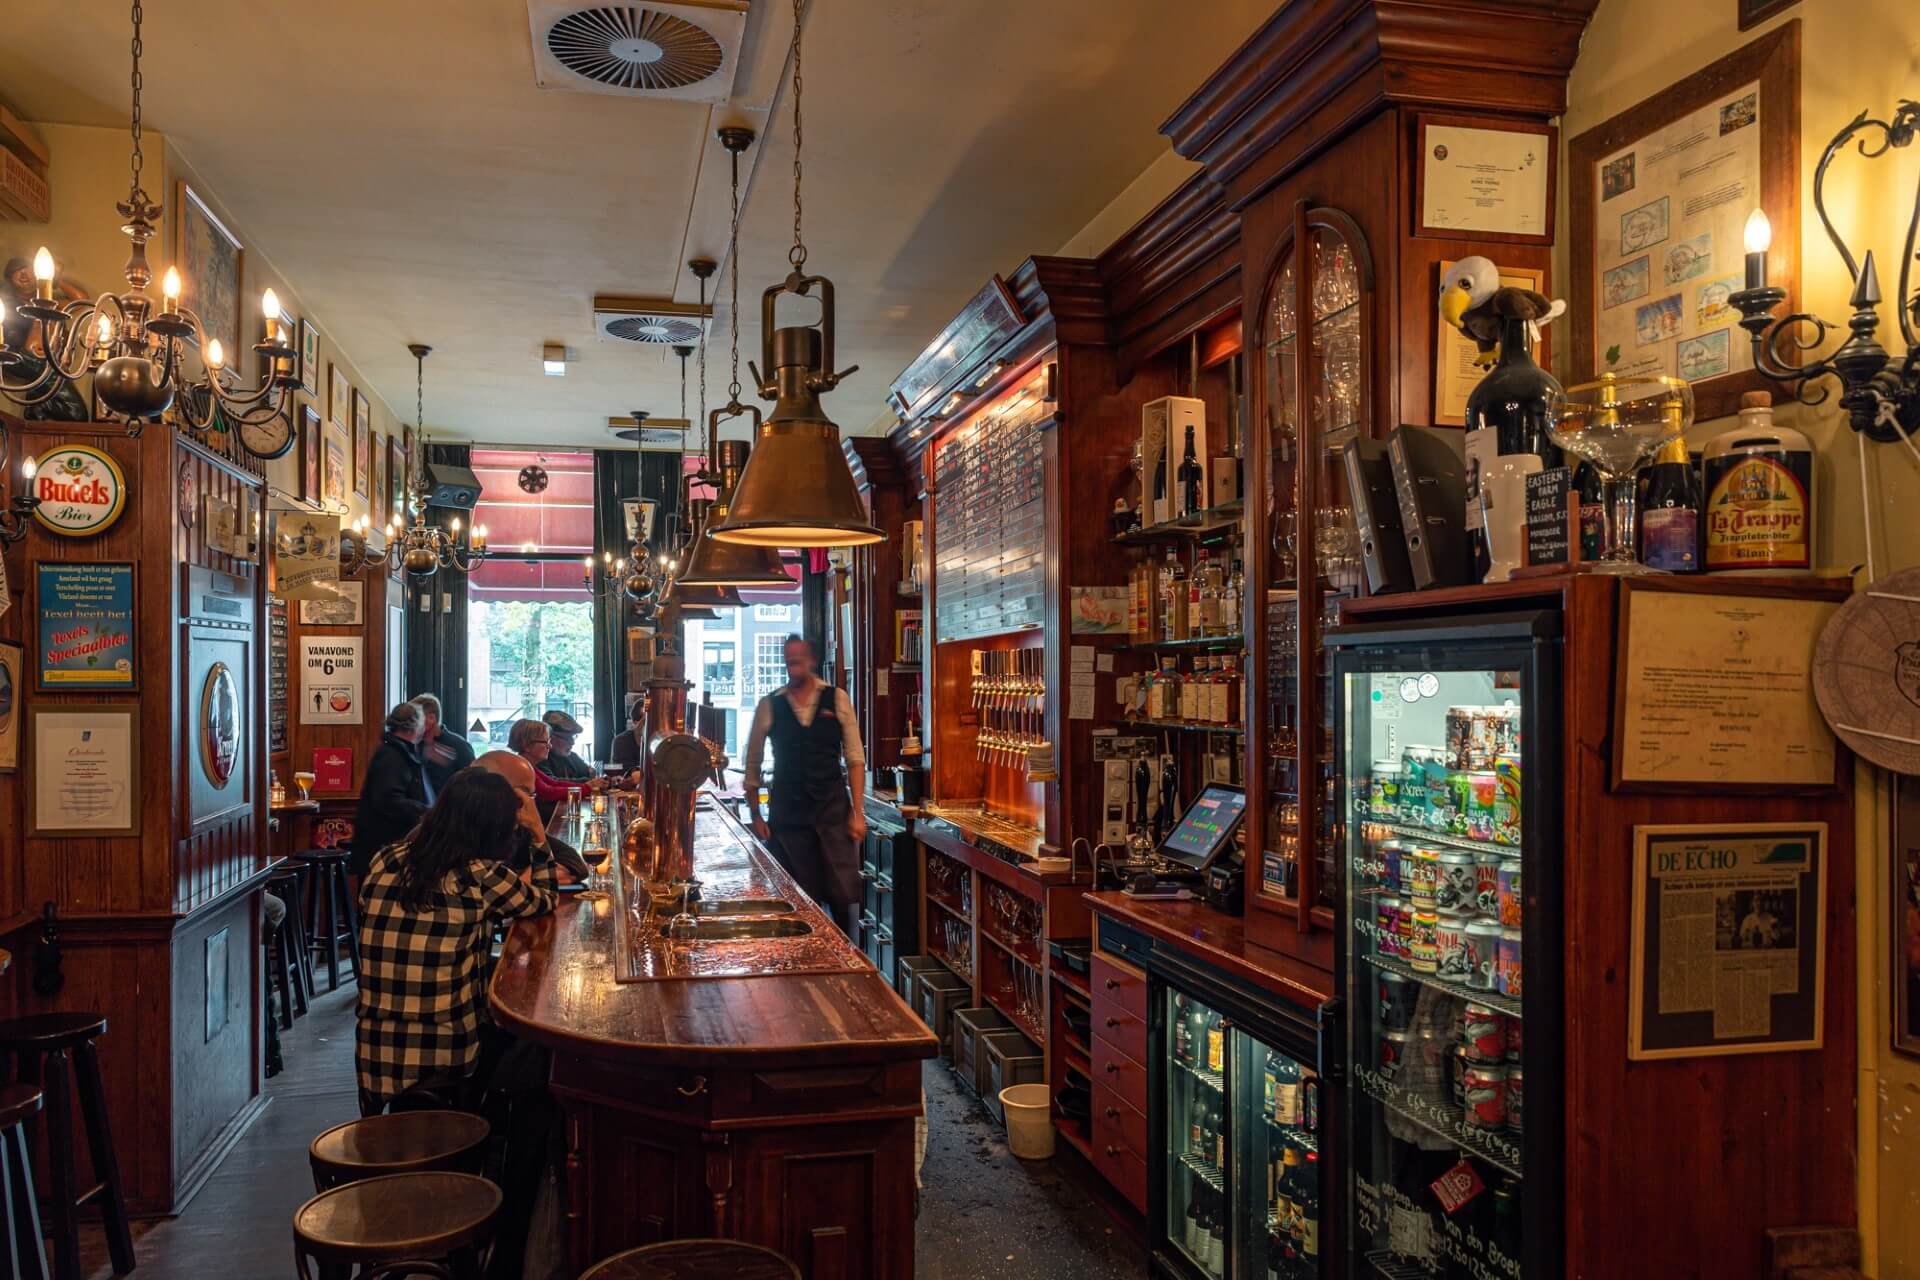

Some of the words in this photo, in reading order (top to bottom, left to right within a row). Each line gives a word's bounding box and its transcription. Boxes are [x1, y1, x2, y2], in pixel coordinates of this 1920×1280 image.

[1528, 471, 1563, 488] EASTERN
[39, 477, 110, 505] Budels
[1538, 484, 1559, 497] FARM
[55, 506, 93, 521] Bier
[1531, 497, 1557, 511] EAGLE
[1712, 510, 1729, 533] La
[1730, 508, 1803, 535] Trappe
[51, 624, 90, 646] Texels
[47, 632, 129, 664] Speciaalbier
[308, 646, 354, 656] VANAVOND
[308, 659, 322, 668] OM
[323, 658, 334, 676] 6
[335, 659, 354, 668] UUR
[1657, 852, 1682, 872] DE
[1685, 849, 1739, 871] ECHO
[1467, 1224, 1483, 1253] den
